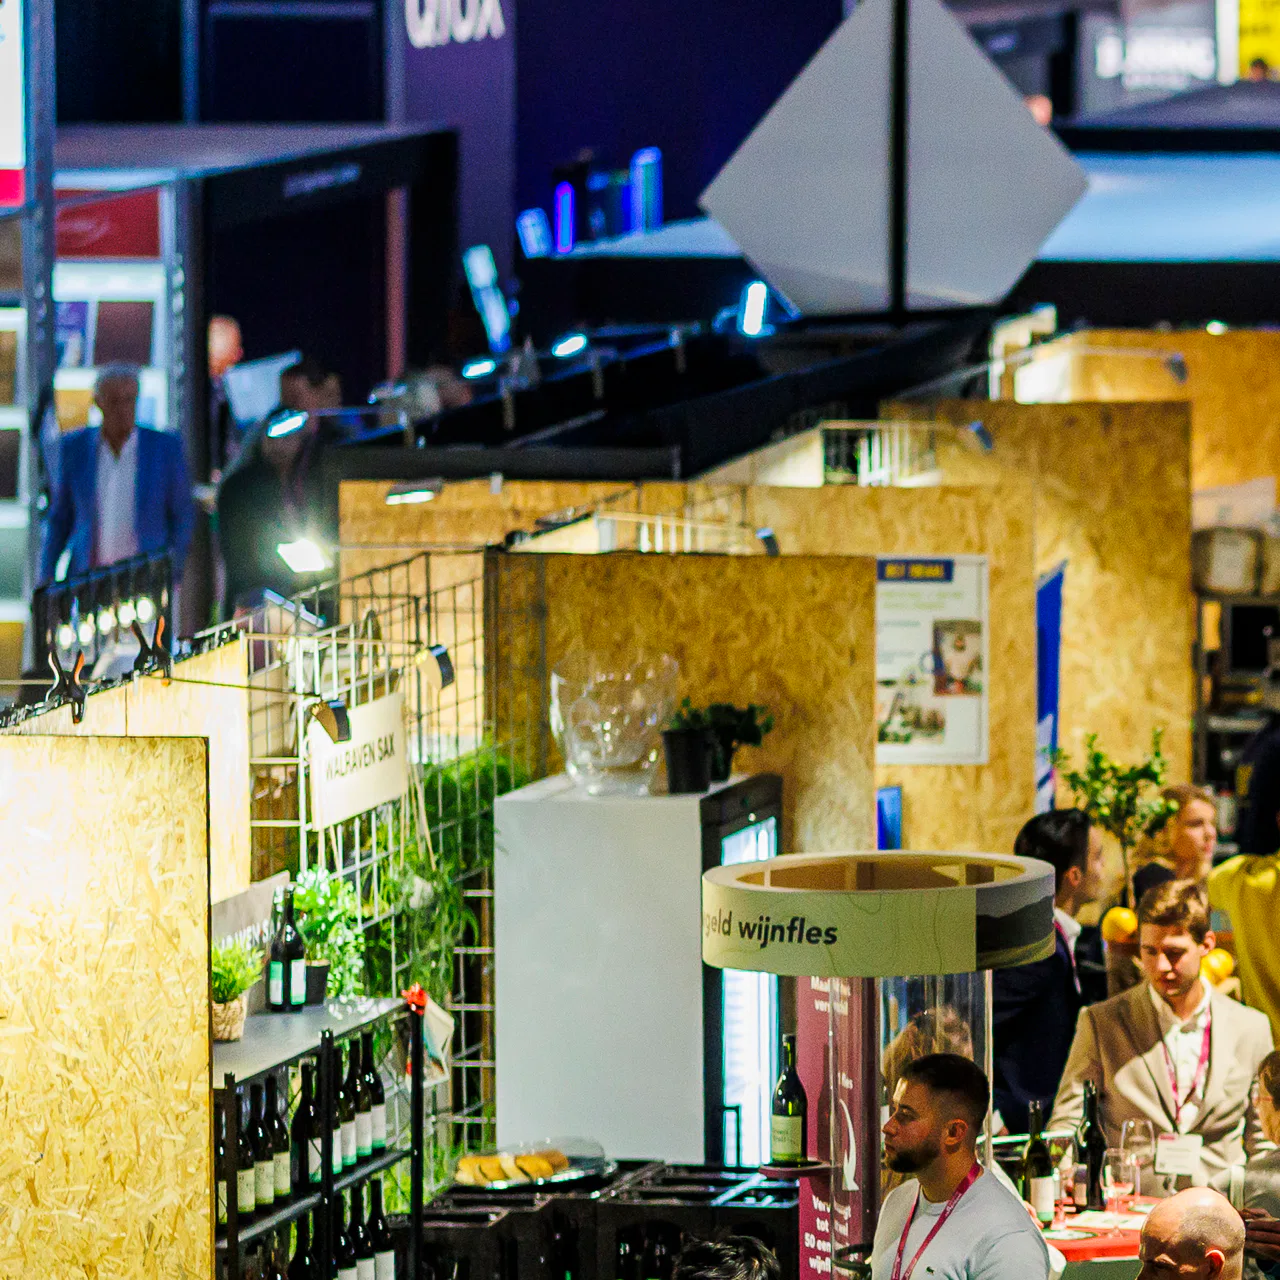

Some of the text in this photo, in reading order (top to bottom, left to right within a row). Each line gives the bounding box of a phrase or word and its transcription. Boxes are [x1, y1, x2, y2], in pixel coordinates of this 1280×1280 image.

[378, 732, 395, 762] SAX
[739, 914, 838, 949] wijnfles
[804, 1232, 816, 1248] 50
